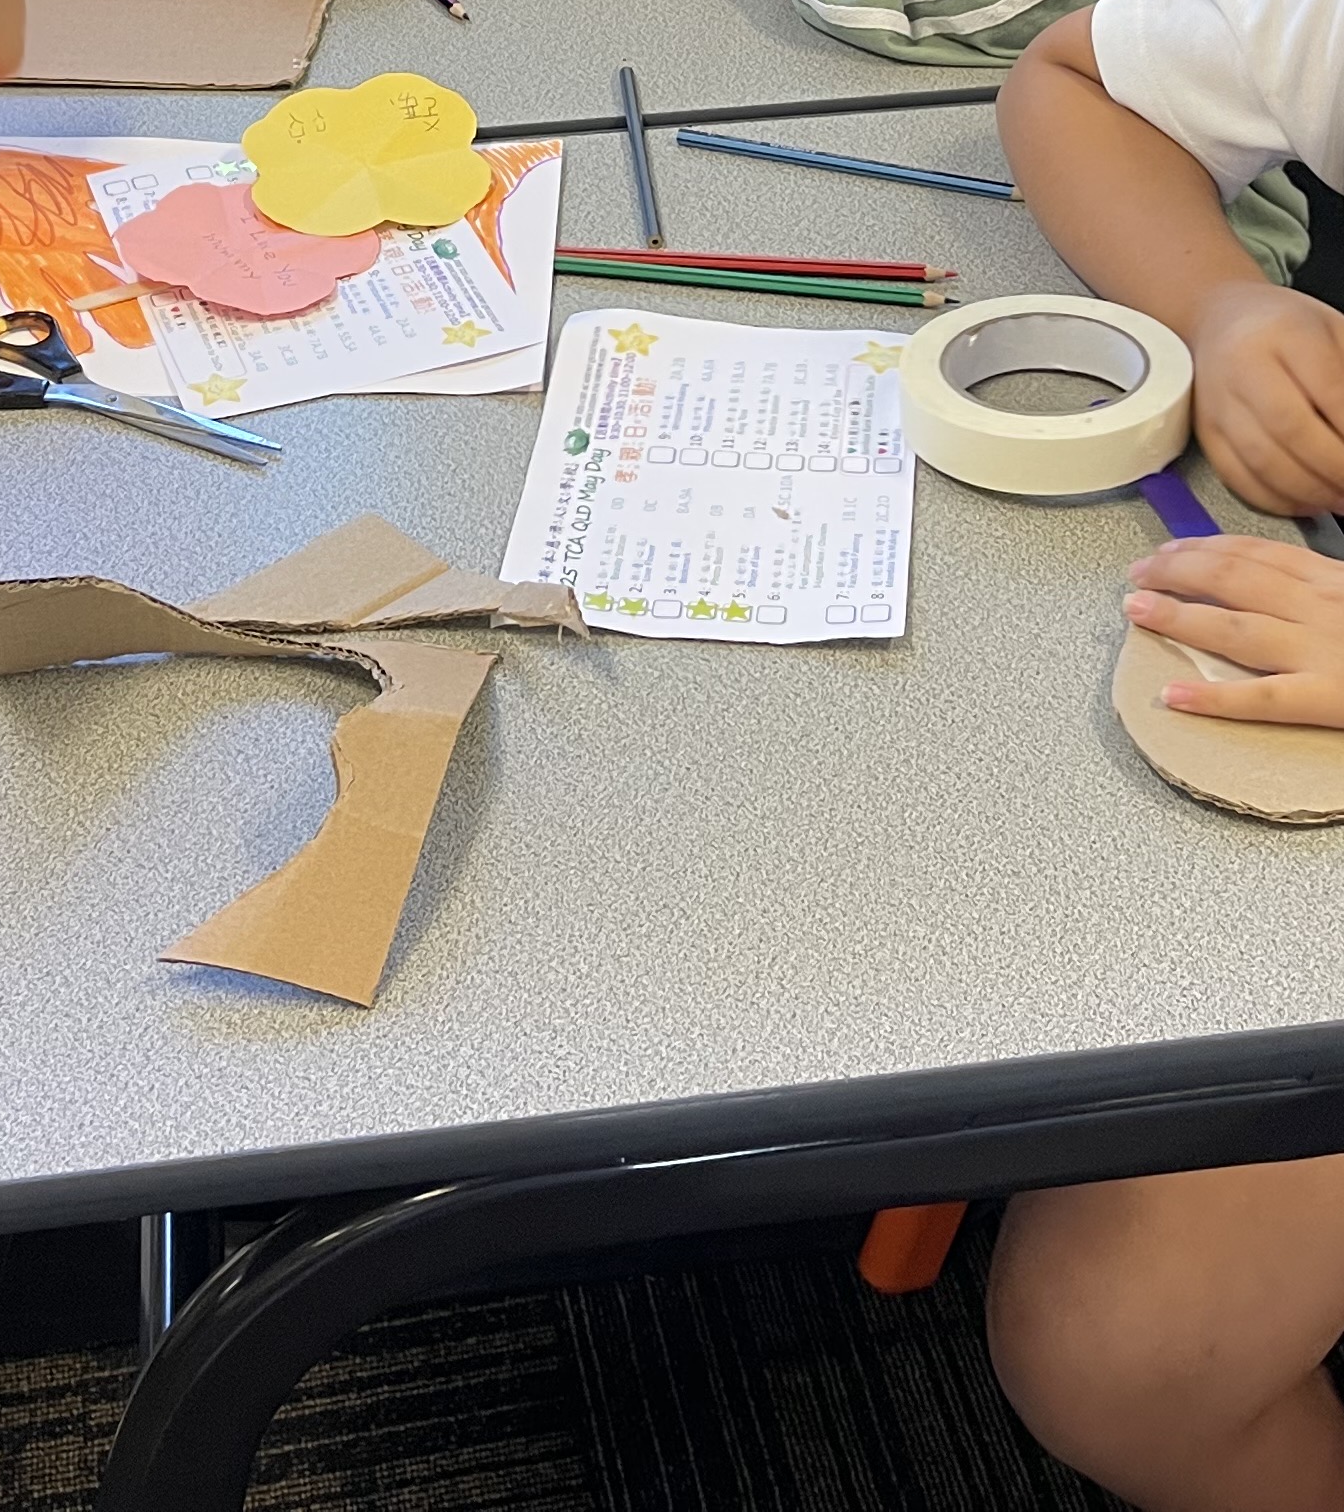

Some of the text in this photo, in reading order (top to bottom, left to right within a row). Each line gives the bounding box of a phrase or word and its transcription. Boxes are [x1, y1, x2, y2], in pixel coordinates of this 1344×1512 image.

[407, 231, 428, 252] Day
[584, 448, 611, 471] Day
[577, 476, 605, 502] May
[571, 505, 592, 531] QLD
[564, 535, 586, 562] TCA
